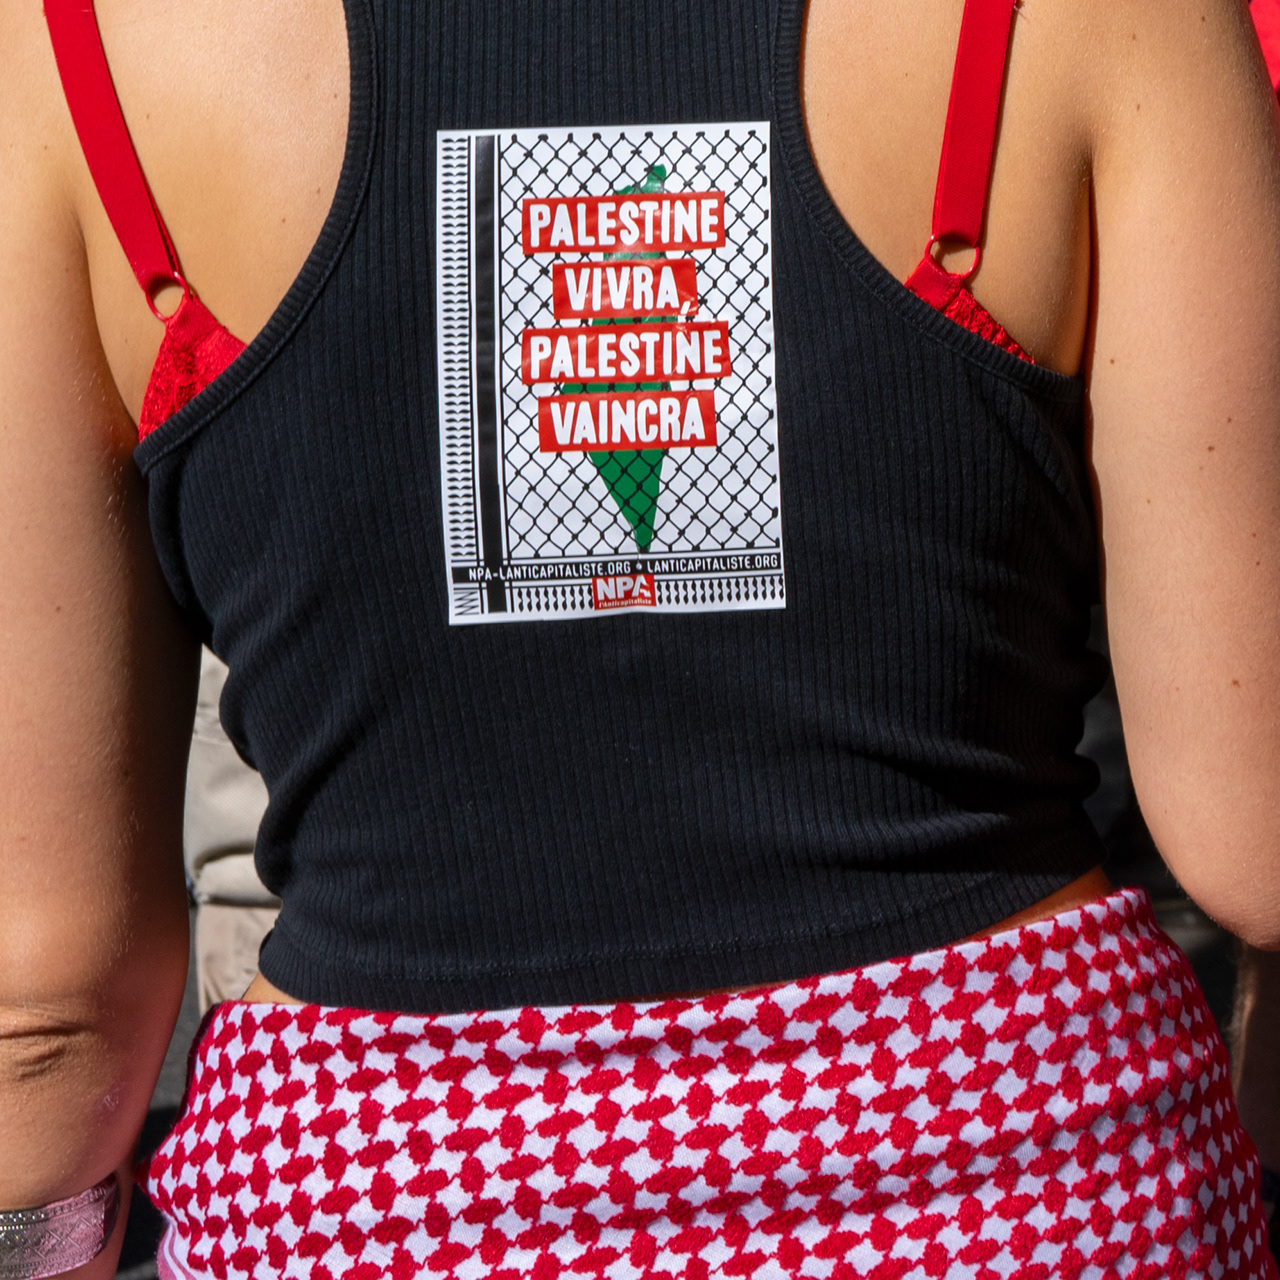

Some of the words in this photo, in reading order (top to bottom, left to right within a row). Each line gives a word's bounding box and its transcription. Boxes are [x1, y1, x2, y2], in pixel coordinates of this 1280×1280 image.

[529, 198, 719, 248] PALESTINE
[564, 265, 691, 315] VIVRA,
[529, 329, 723, 380] PALESTINE
[550, 397, 706, 446] VAINCRA
[469, 560, 631, 582] NPA-LANTICAPITALISTE.ORG
[646, 553, 779, 574] LANTICAPITALISTE.ORG
[596, 574, 652, 601] NPA
